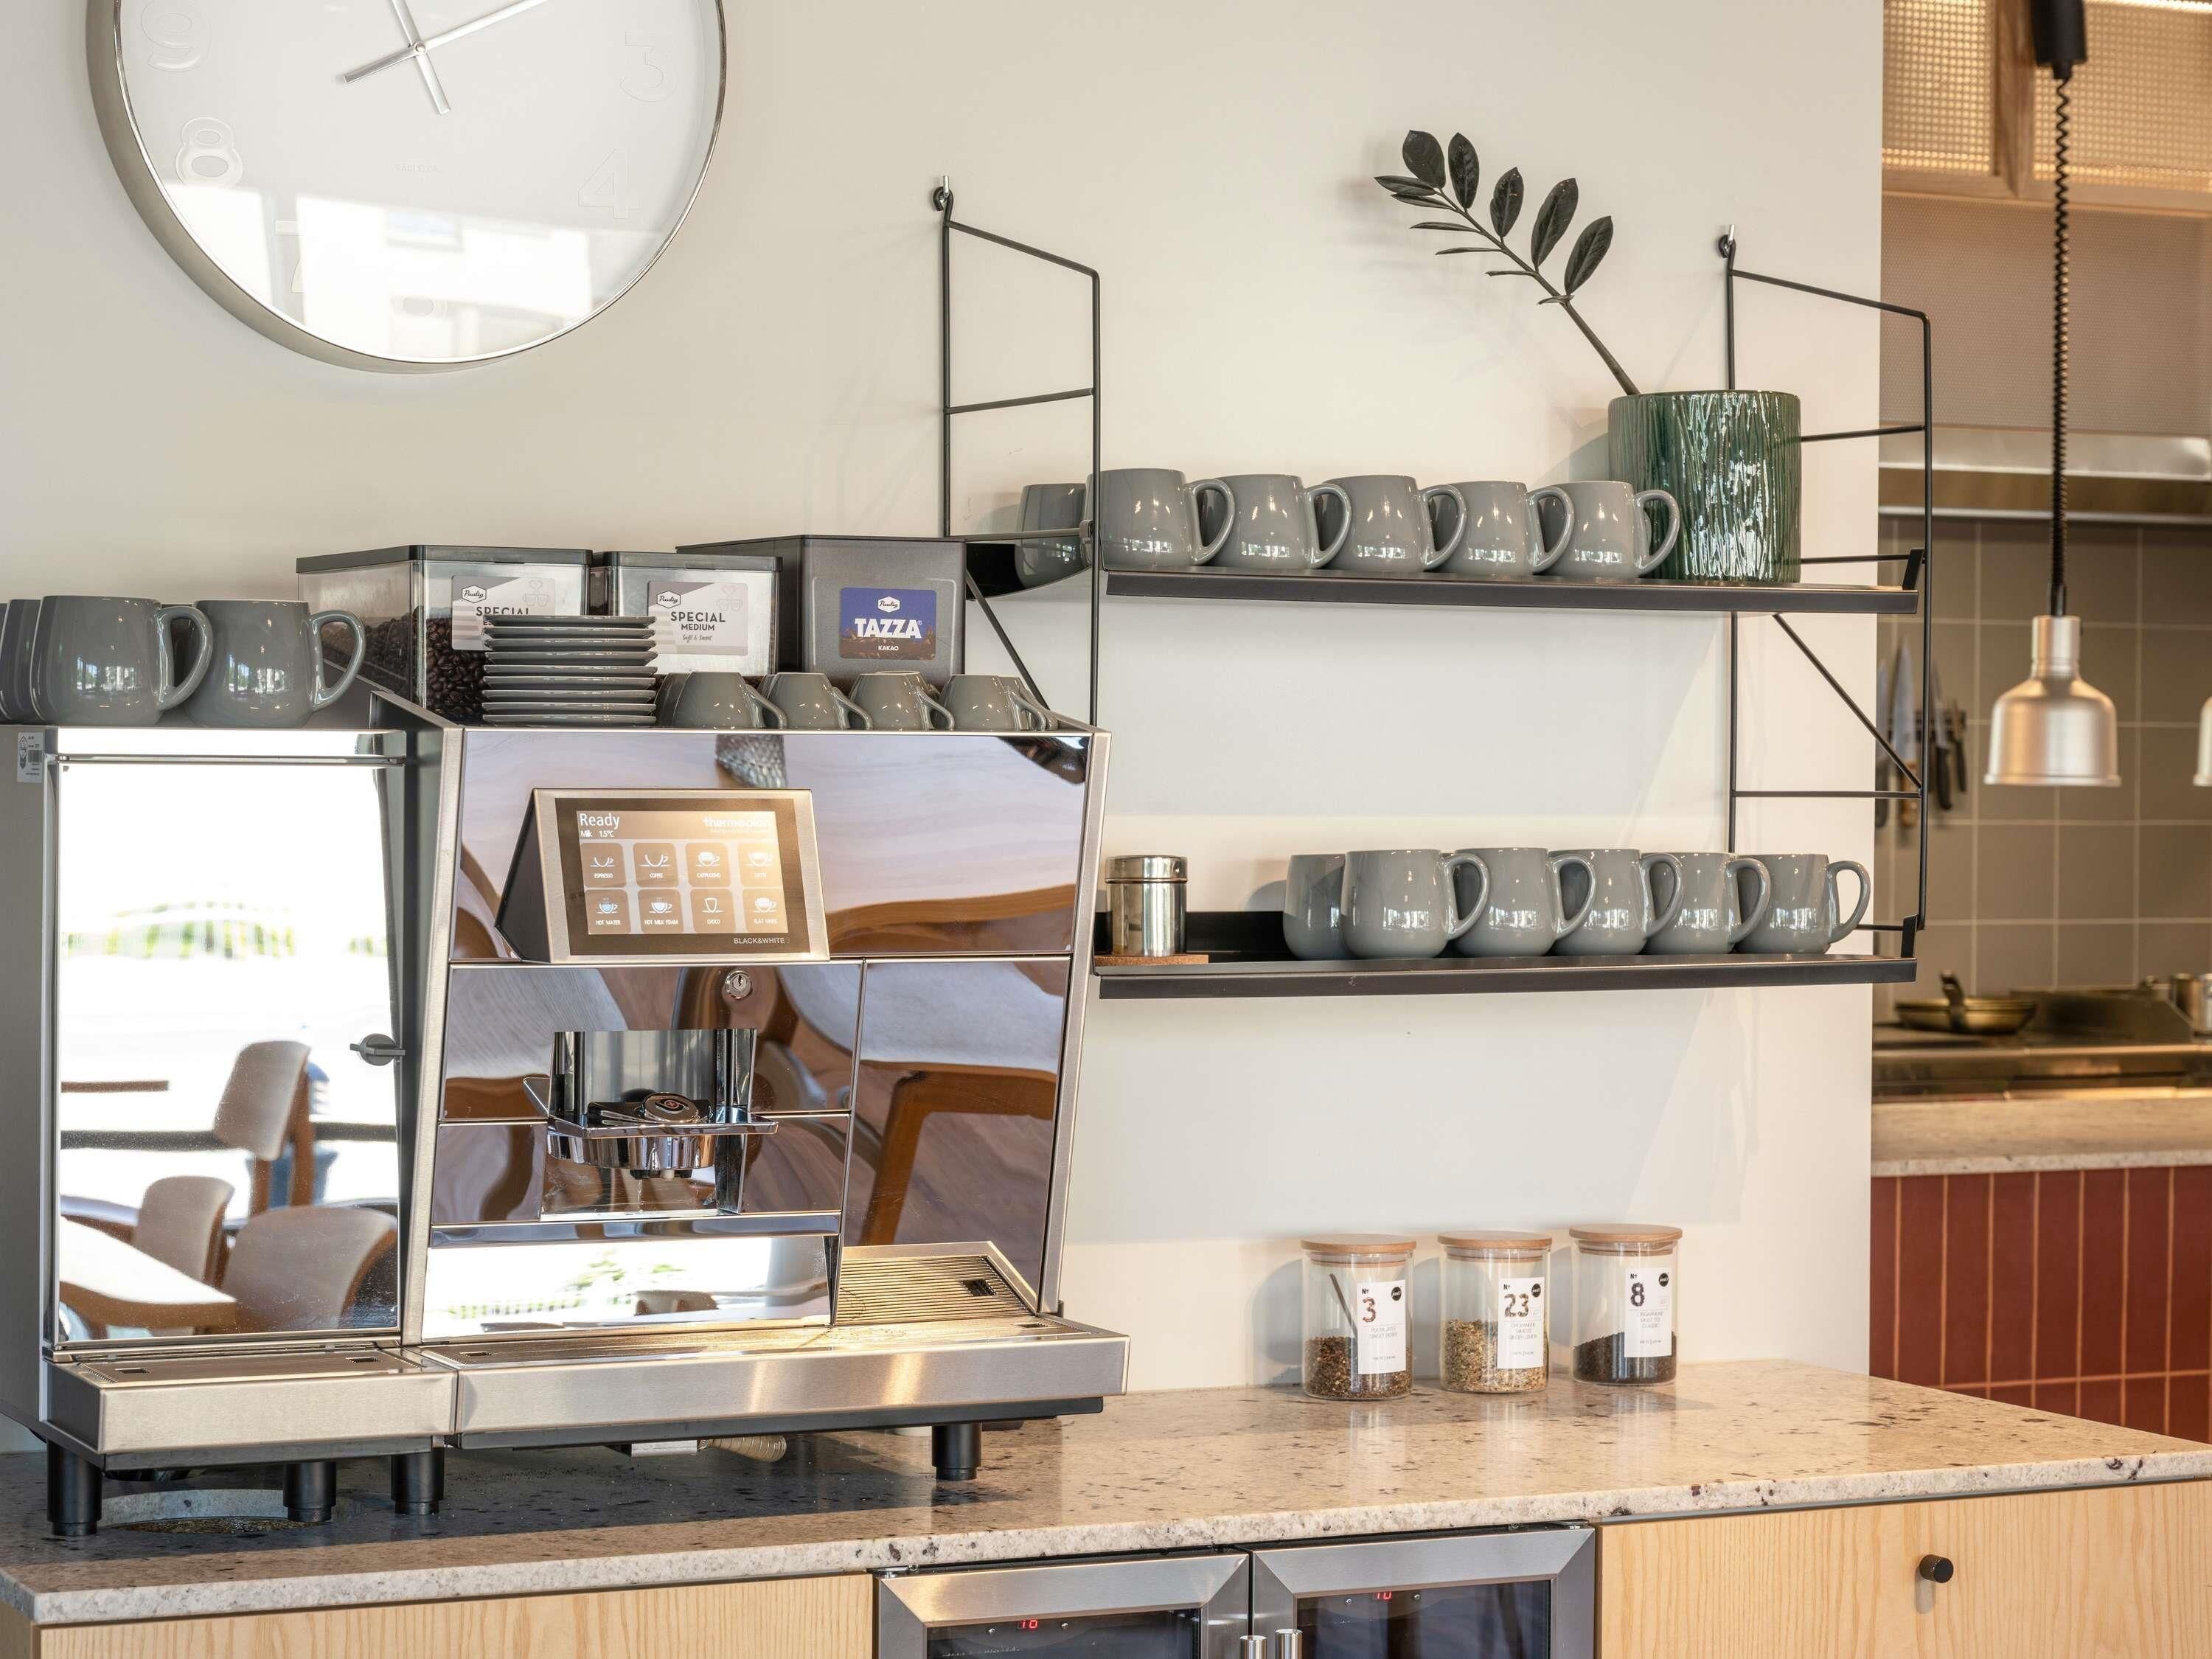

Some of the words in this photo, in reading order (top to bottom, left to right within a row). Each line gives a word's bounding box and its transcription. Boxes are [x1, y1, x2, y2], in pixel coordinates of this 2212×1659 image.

[175, 116, 243, 189] 8
[577, 145, 641, 220] 4
[464, 590, 484, 599] Paulig
[658, 595, 678, 605] Paulig
[879, 600, 898, 608] Paulig
[670, 611, 726, 623] SPECIAL
[580, 813, 620, 830] Ready
[1630, 1282, 1645, 1307] 8
[1362, 1297, 1376, 1323] 3
[1504, 1293, 1528, 1318] 23
